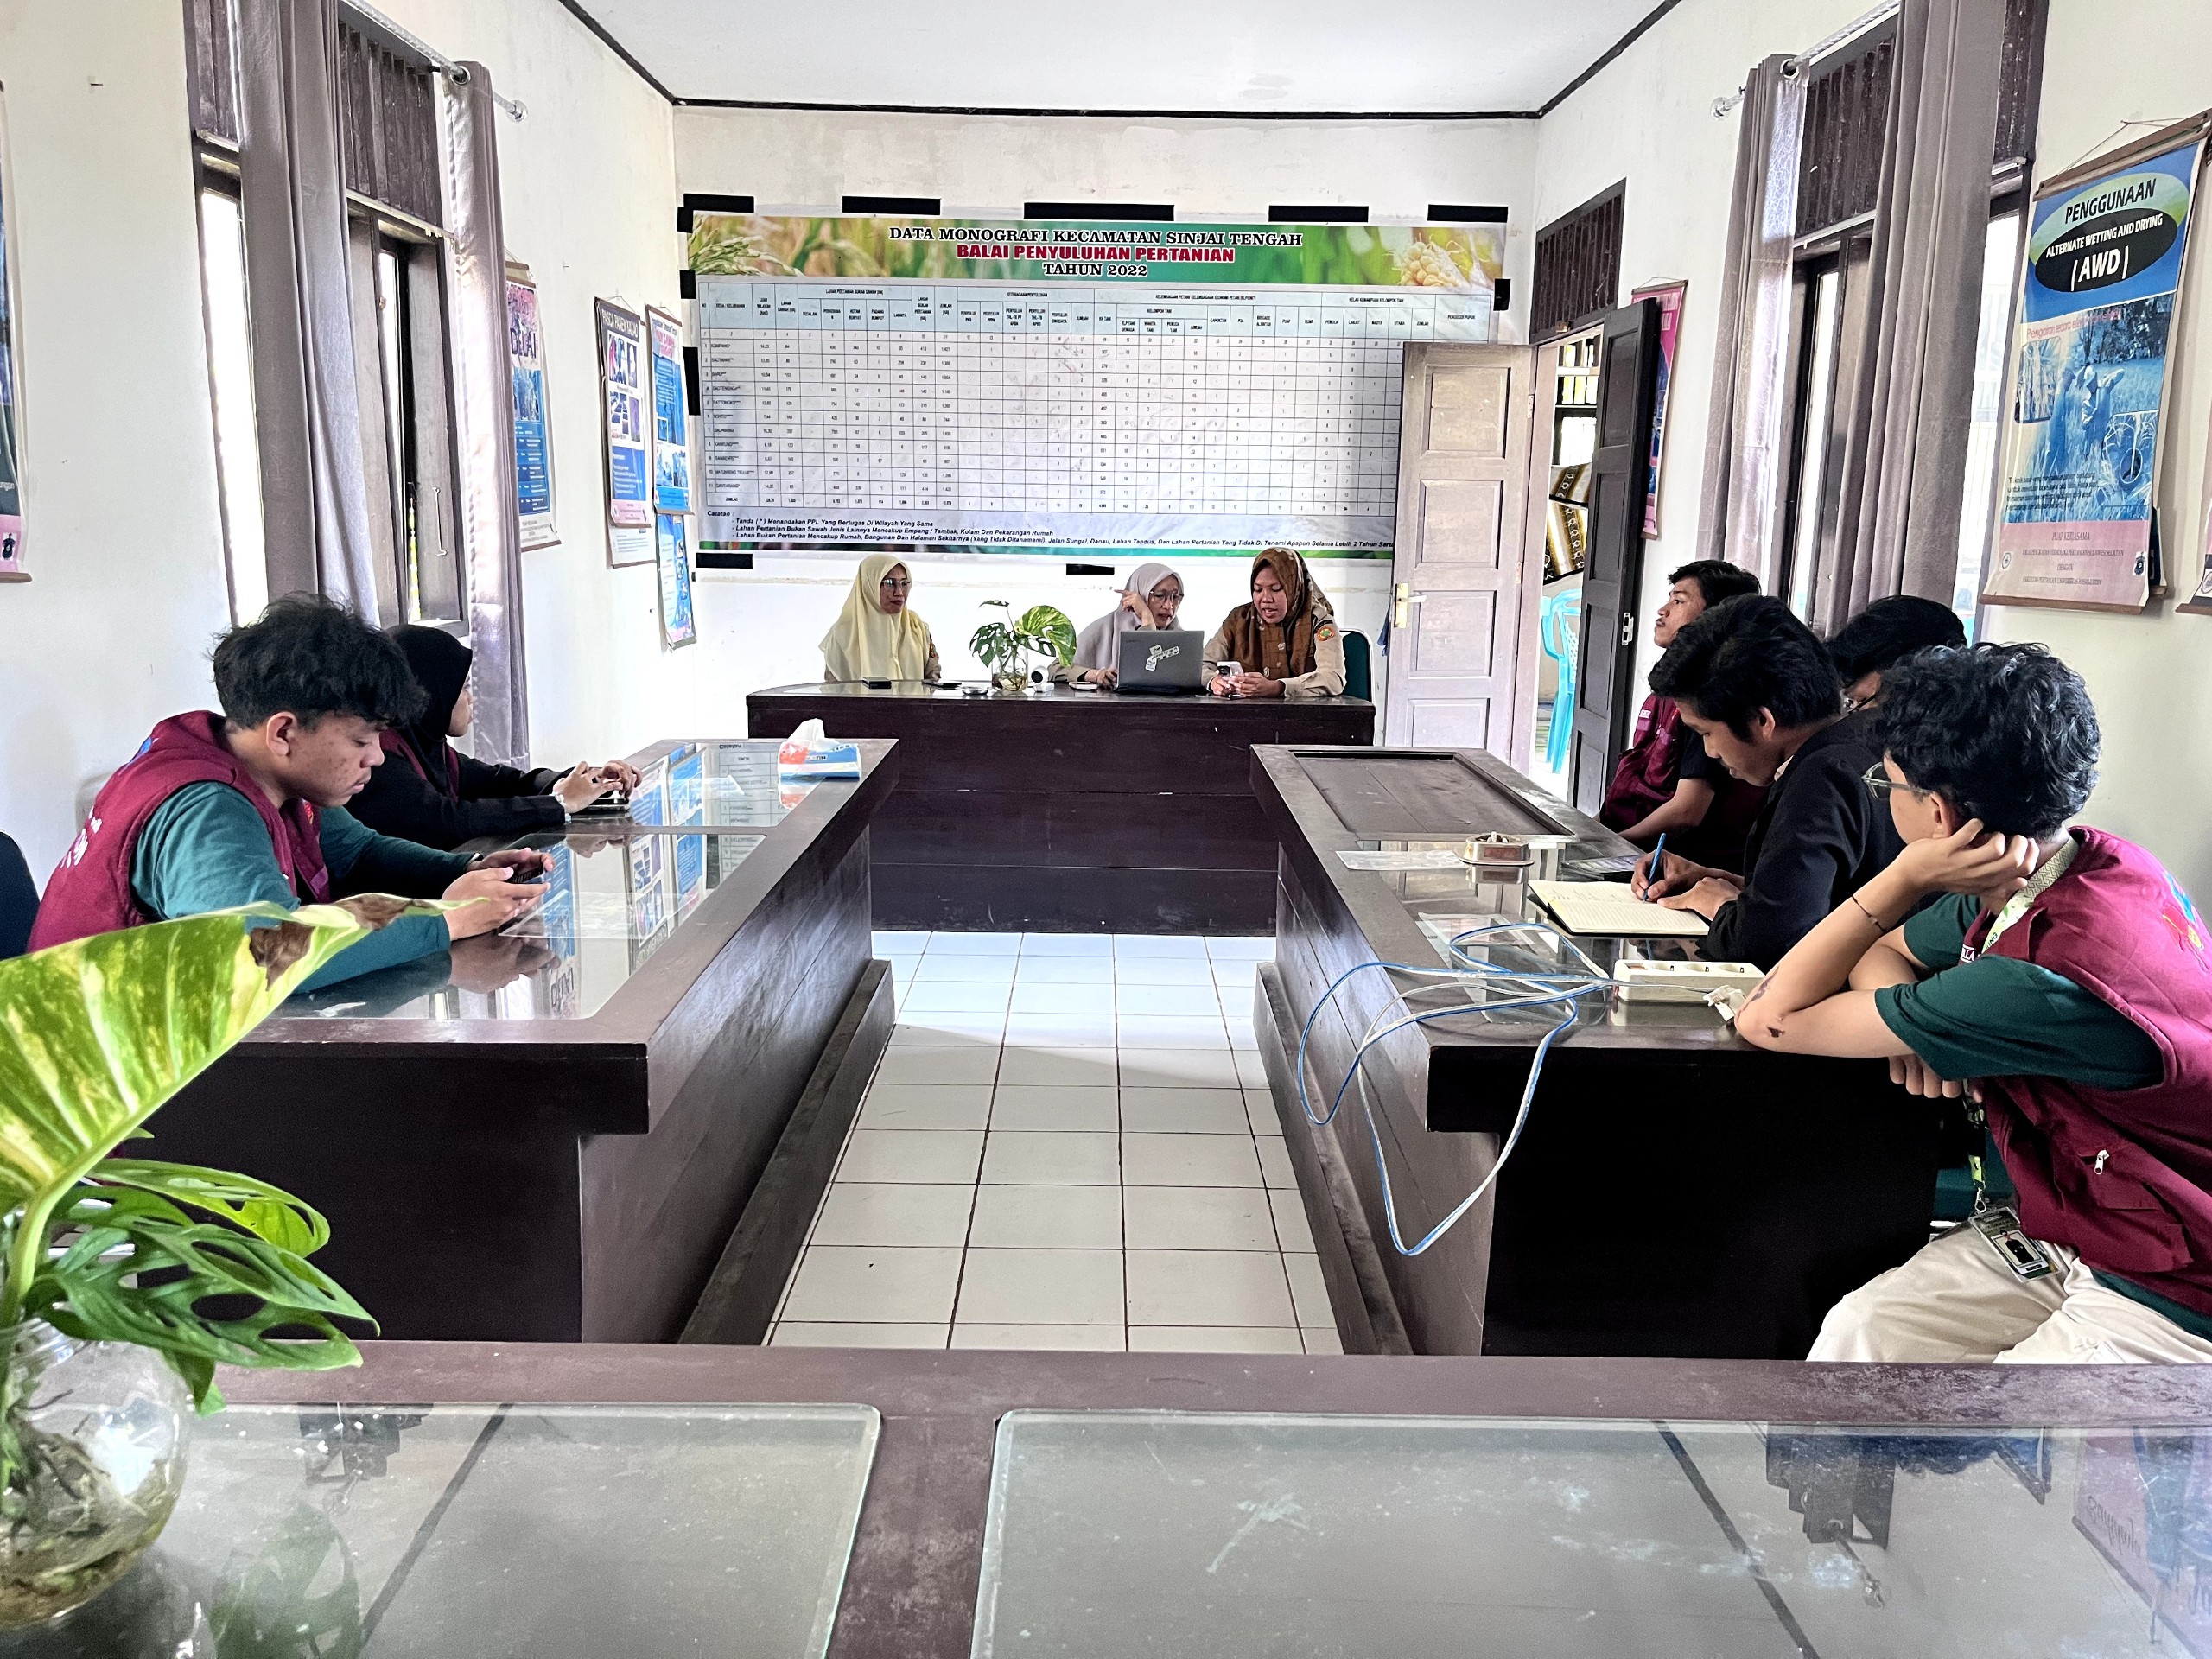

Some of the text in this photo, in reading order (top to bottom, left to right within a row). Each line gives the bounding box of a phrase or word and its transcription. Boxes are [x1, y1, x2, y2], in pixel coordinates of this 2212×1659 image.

[2065, 178, 2157, 224] PENGGUNAAN
[890, 228, 1302, 245] DATA MONOGRAFI KECAMATAN SINJAI TENGAH
[2046, 213, 2163, 258] ALTERNATE WETTING AND DRYING
[957, 245, 1234, 261] BALAI PENYULUHAN PERTANIAN
[1043, 263, 1147, 276] TAHUN 2022
